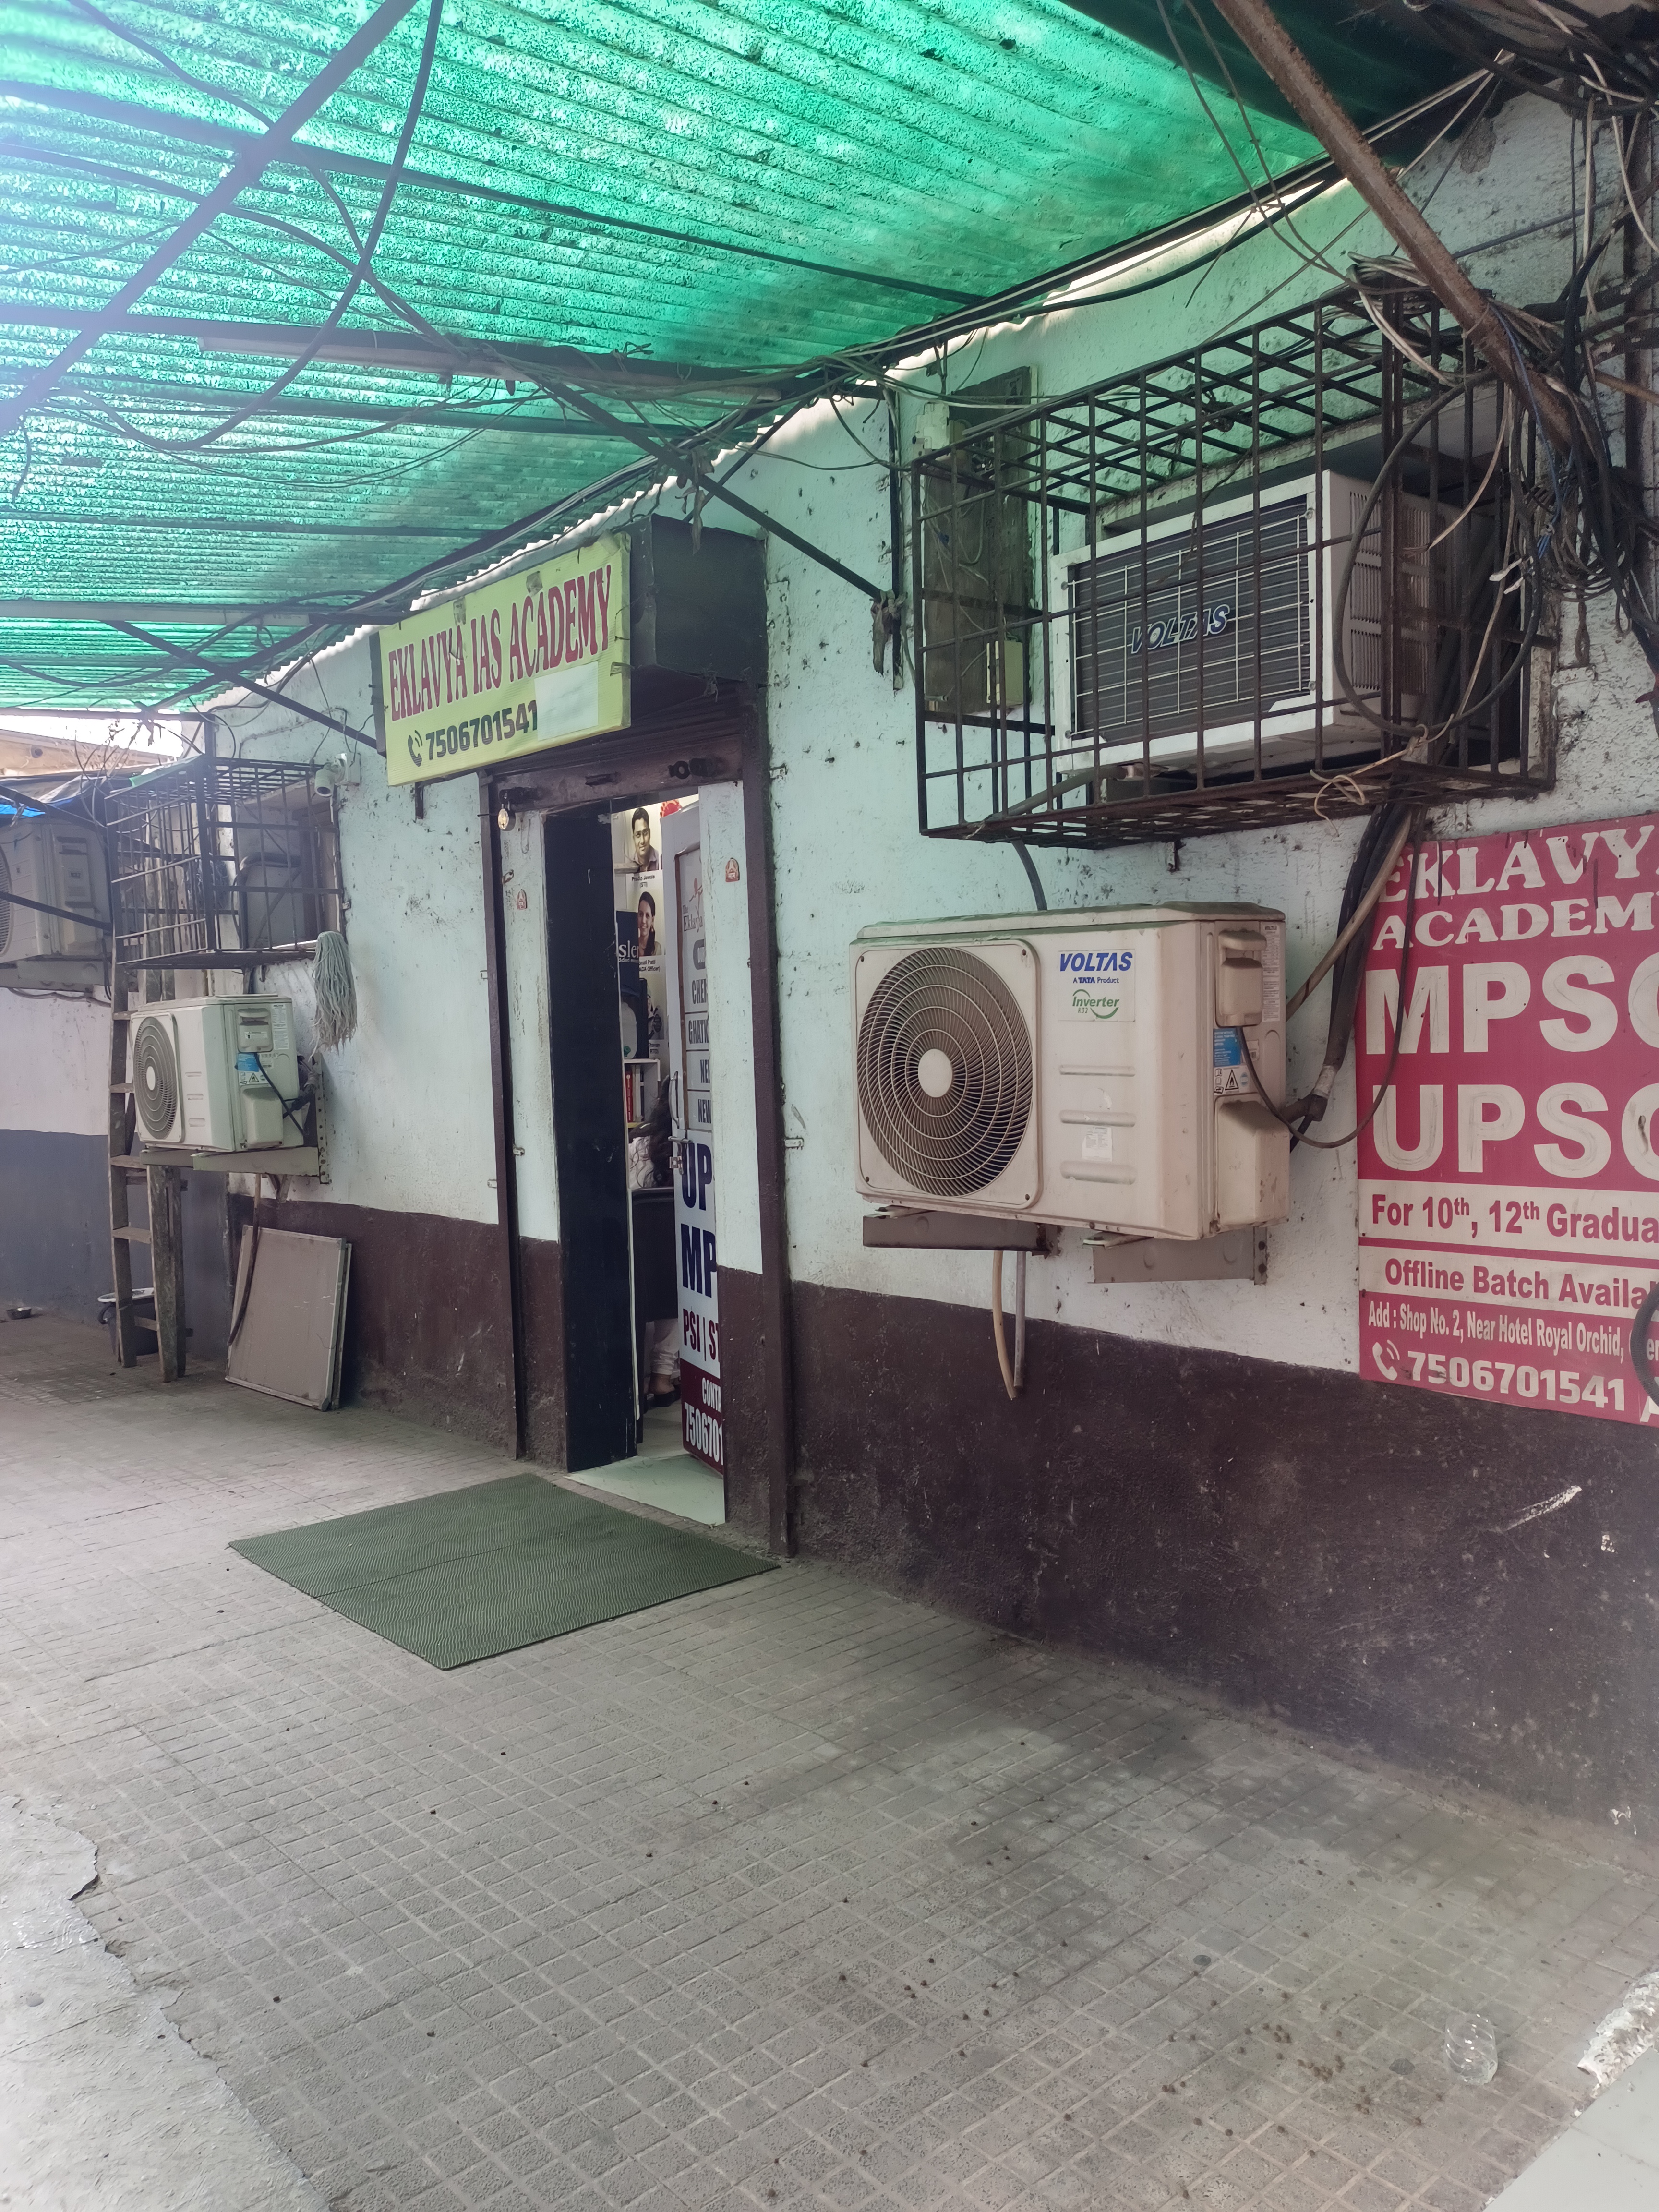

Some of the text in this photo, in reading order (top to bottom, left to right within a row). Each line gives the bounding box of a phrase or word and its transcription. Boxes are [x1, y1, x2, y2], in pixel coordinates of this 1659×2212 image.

[388, 564, 612, 721] EKLAVYA IAS ACADEMY
[425, 699, 538, 761] 7506701541
[1378, 825, 1659, 903] EKLAVY
[1372, 891, 1659, 950] ACADEM
[1060, 952, 1133, 972] VOLTAS
[1072, 996, 1120, 1007] Inverter
[1372, 1194, 1414, 1227] For
[1489, 1200, 1540, 1234] 12th
[1384, 1258, 1659, 1310] Offline Batch Availa
[1400, 1303, 1427, 1339] Shop
[1430, 1306, 1450, 1336] No.
[1453, 1309, 1464, 1344] 2,
[1467, 1310, 1496, 1342] Near
[1499, 1314, 1533, 1346] Hotel
[1536, 1318, 1572, 1356] Royal
[1576, 1322, 1624, 1363] Orchid,
[1407, 1350, 1625, 1411] 7506701541
